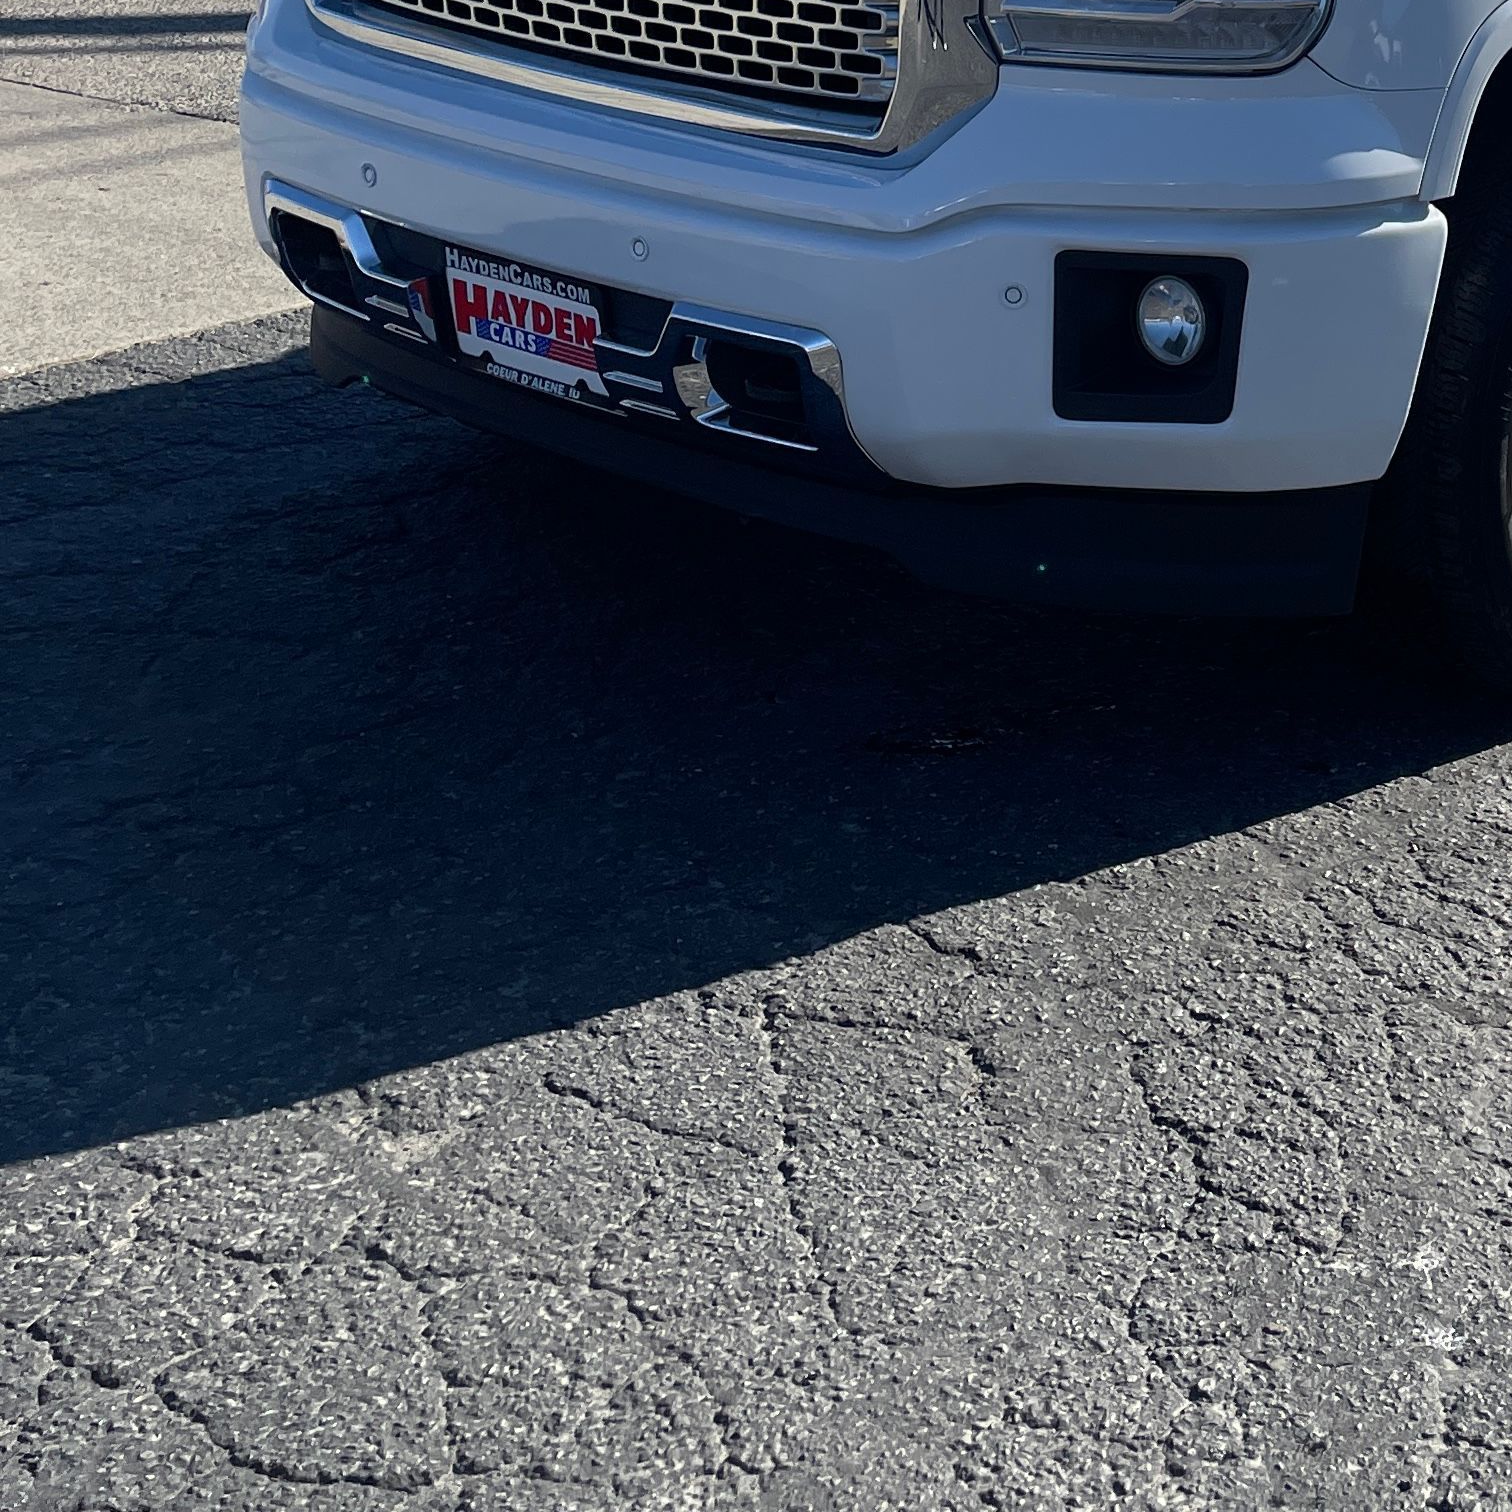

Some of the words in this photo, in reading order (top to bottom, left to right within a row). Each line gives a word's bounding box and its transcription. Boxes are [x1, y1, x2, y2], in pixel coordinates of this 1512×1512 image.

[444, 246, 591, 305] HAYDENCARS.COM
[452, 278, 597, 350] HAYDEN
[489, 322, 538, 353] CARS
[486, 362, 519, 383] COEUR
